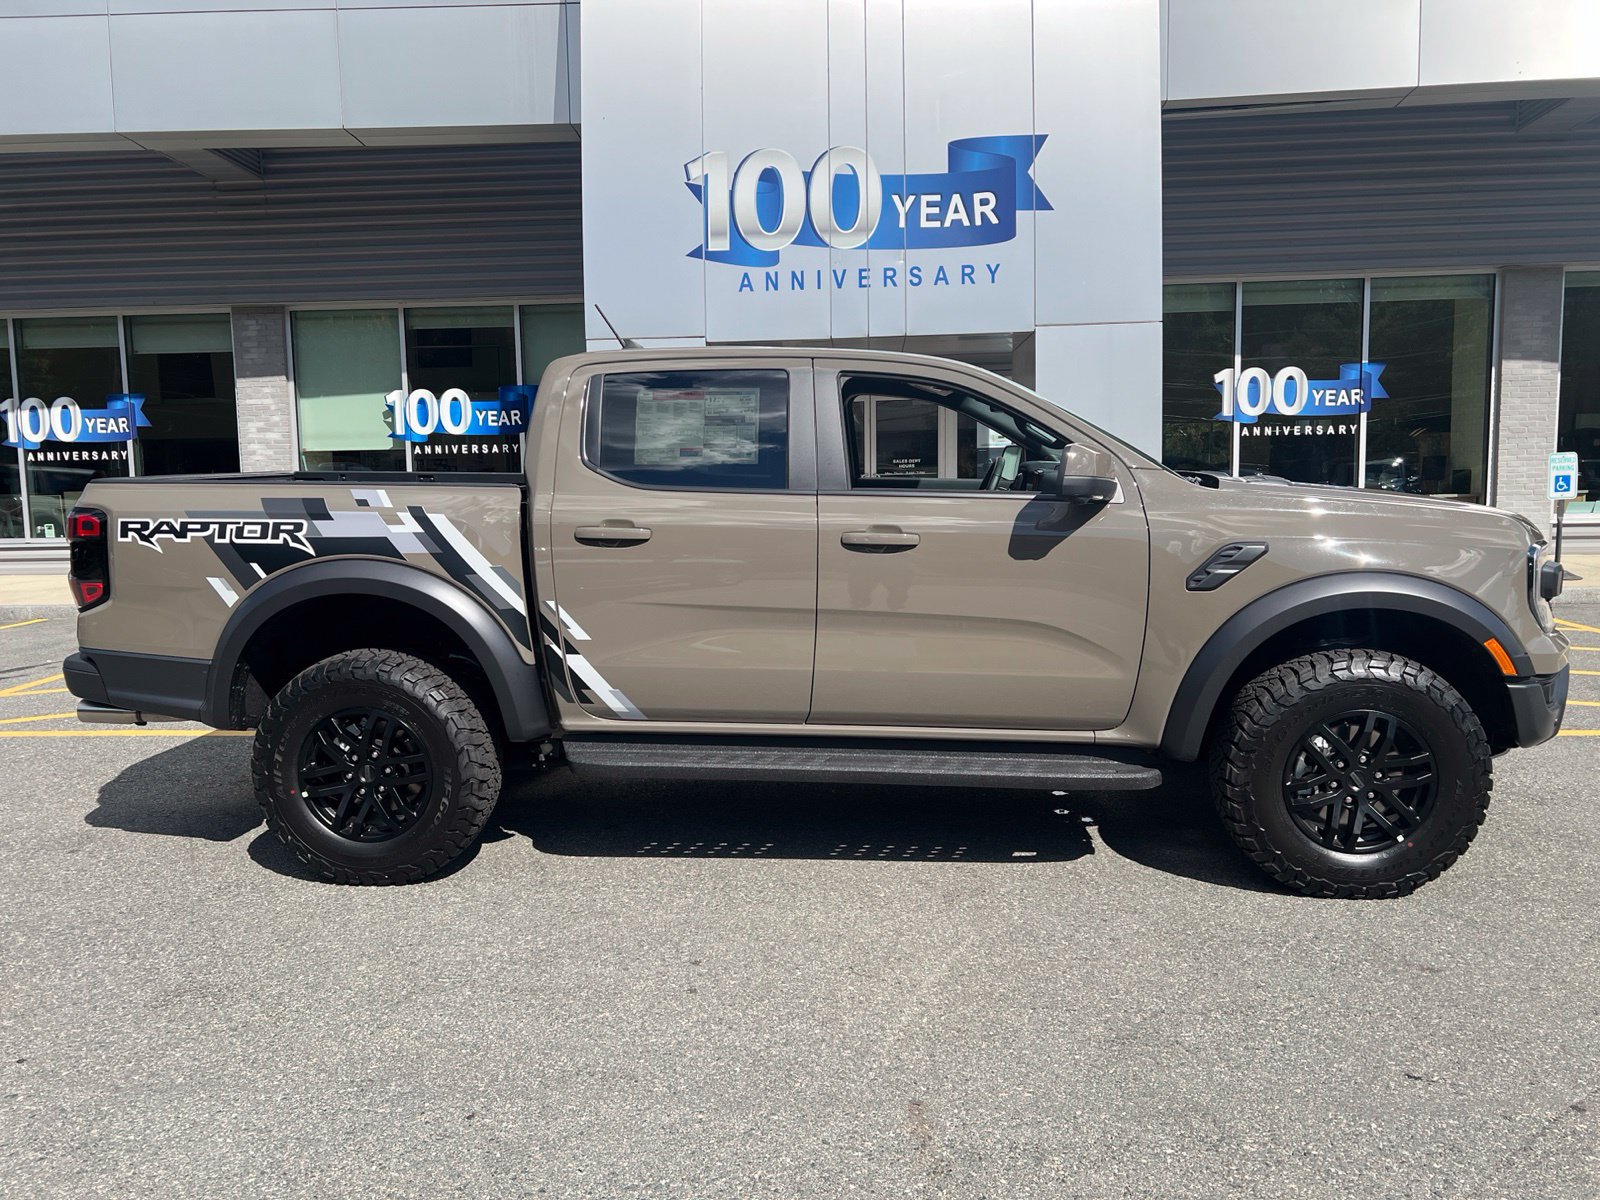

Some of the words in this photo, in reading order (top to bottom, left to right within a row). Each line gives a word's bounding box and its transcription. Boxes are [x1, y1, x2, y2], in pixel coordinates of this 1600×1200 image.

[685, 146, 882, 251] 100
[892, 191, 999, 228] YEAR
[739, 263, 1001, 292] ANNIVERSARY
[1213, 366, 1309, 416] 100
[1312, 388, 1365, 406] YEAR
[0, 397, 82, 442] 100
[85, 417, 130, 433] YEAR
[385, 388, 472, 435] 100
[475, 409, 522, 426] YEAR
[1241, 424, 1358, 436] ANNIVERSARY
[27, 450, 128, 461] ANNIVERSARY
[414, 444, 519, 454] ANNIVERSARY
[118, 518, 316, 557] RAPTOR
